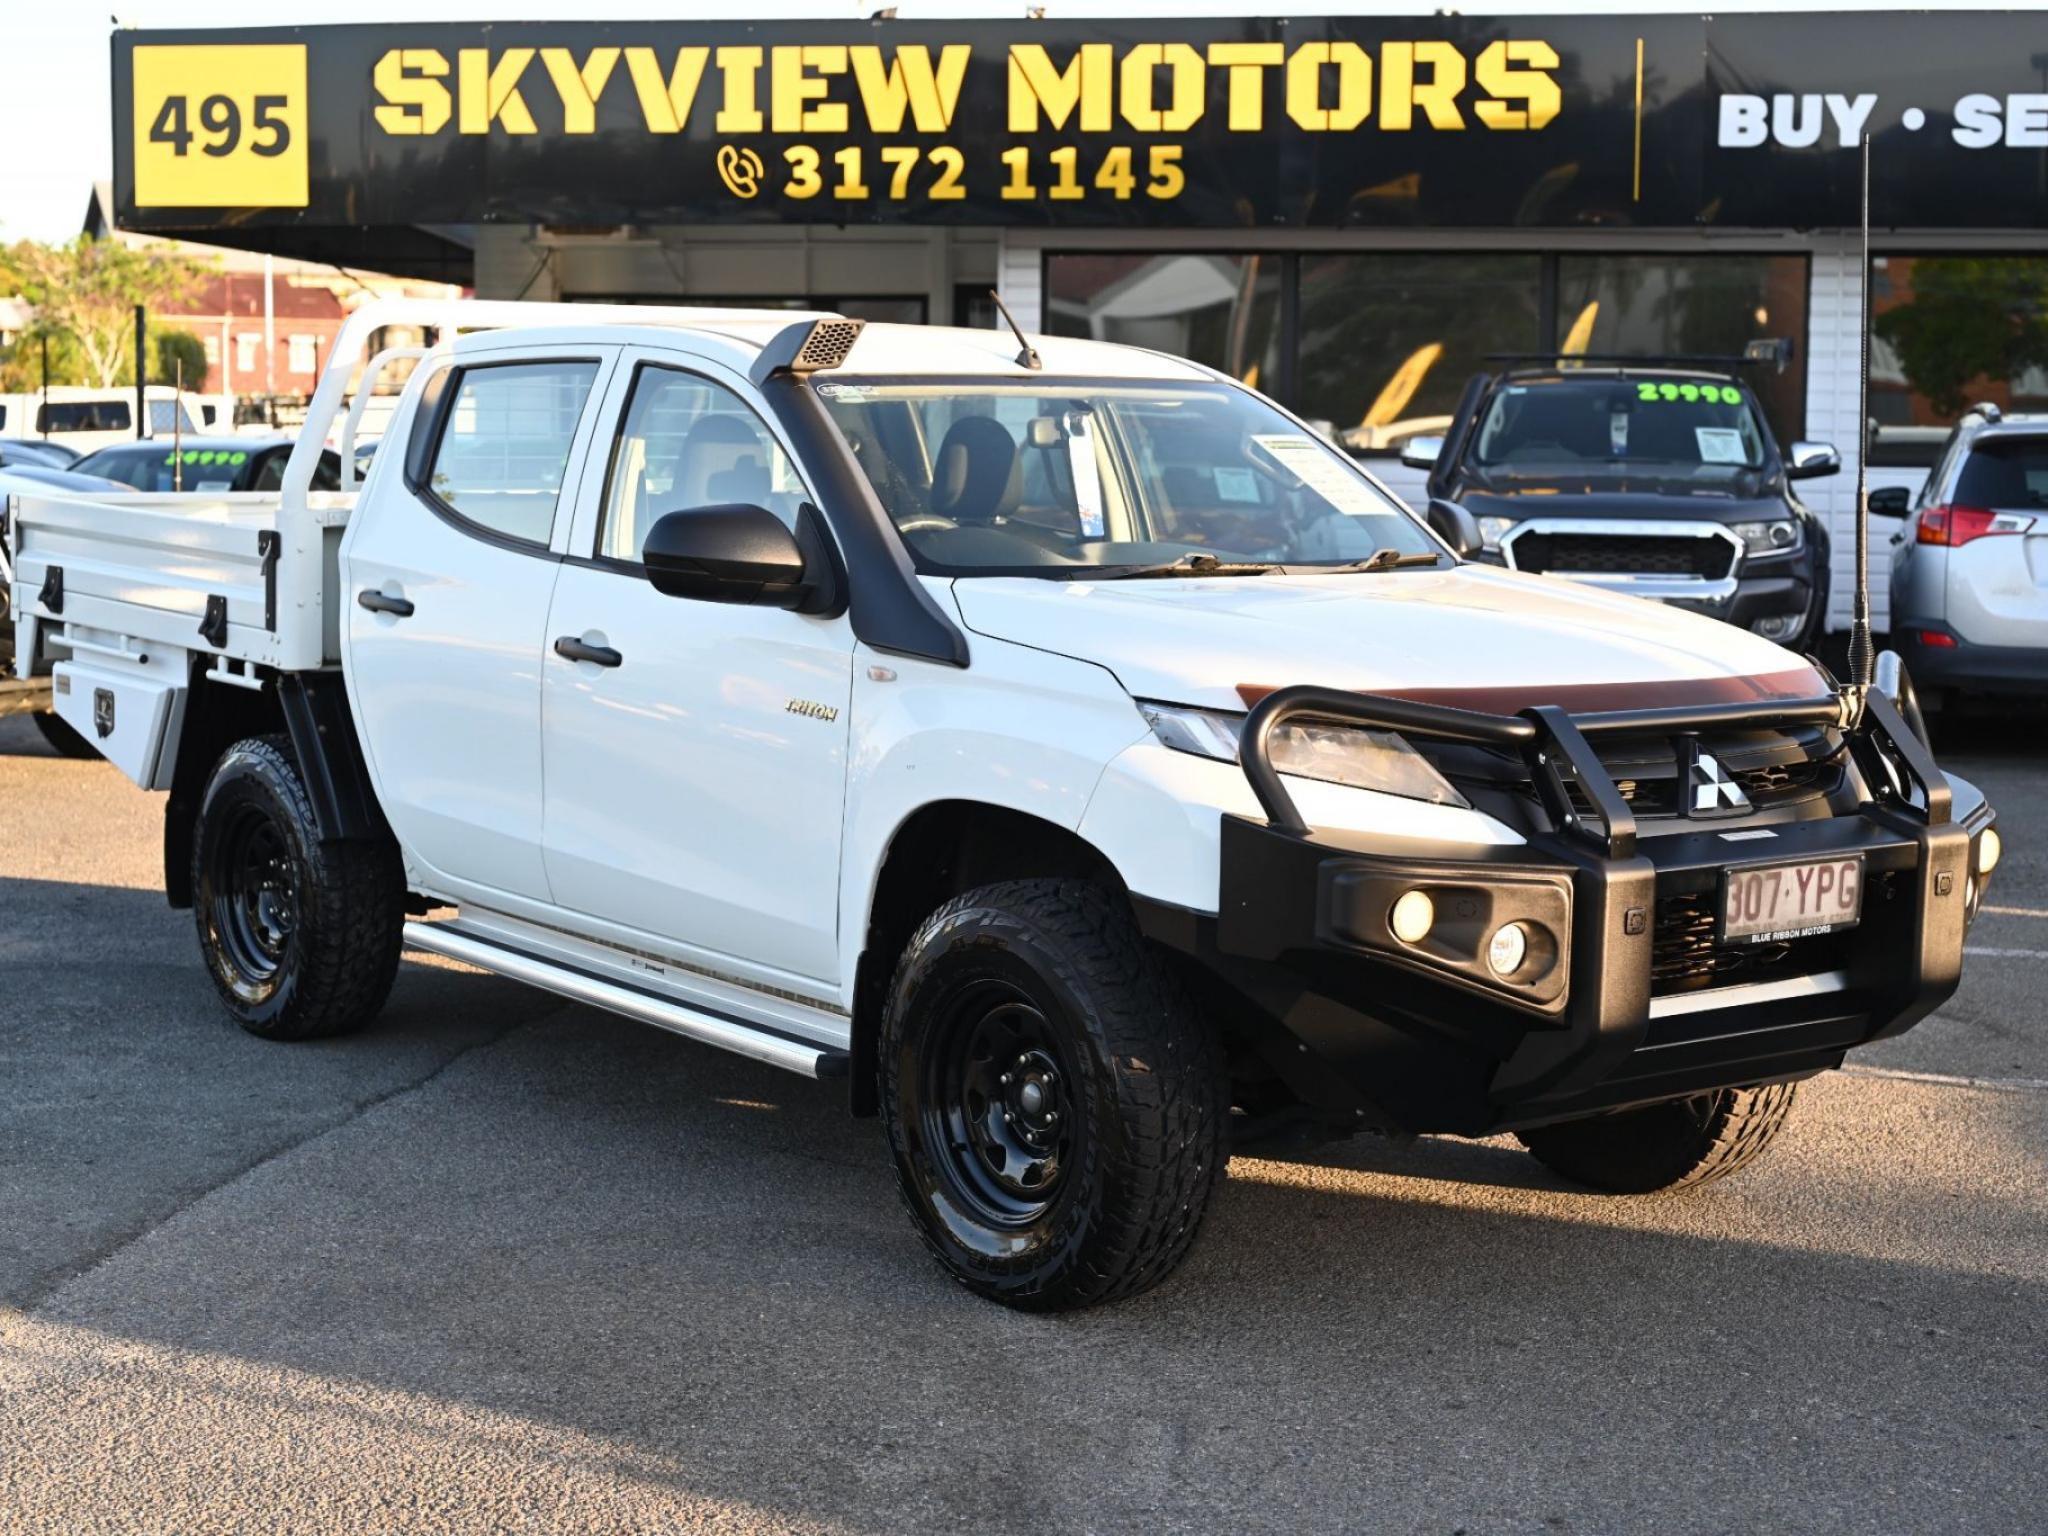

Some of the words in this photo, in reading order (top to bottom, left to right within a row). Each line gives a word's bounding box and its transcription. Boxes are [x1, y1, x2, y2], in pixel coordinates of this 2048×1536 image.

[373, 44, 972, 135] SKYVIEW
[1007, 40, 1562, 133] MOTORS
[149, 94, 290, 157] 495
[1718, 93, 1878, 148] BUY
[1951, 93, 2048, 148] SE
[783, 145, 966, 199] 3172
[1001, 145, 1184, 199] 1145
[1636, 382, 1742, 405] 29990
[1751, 933, 1771, 943] BLUE
[1772, 928, 1800, 941] RIBBON
[1801, 924, 1832, 937] MOTORS
